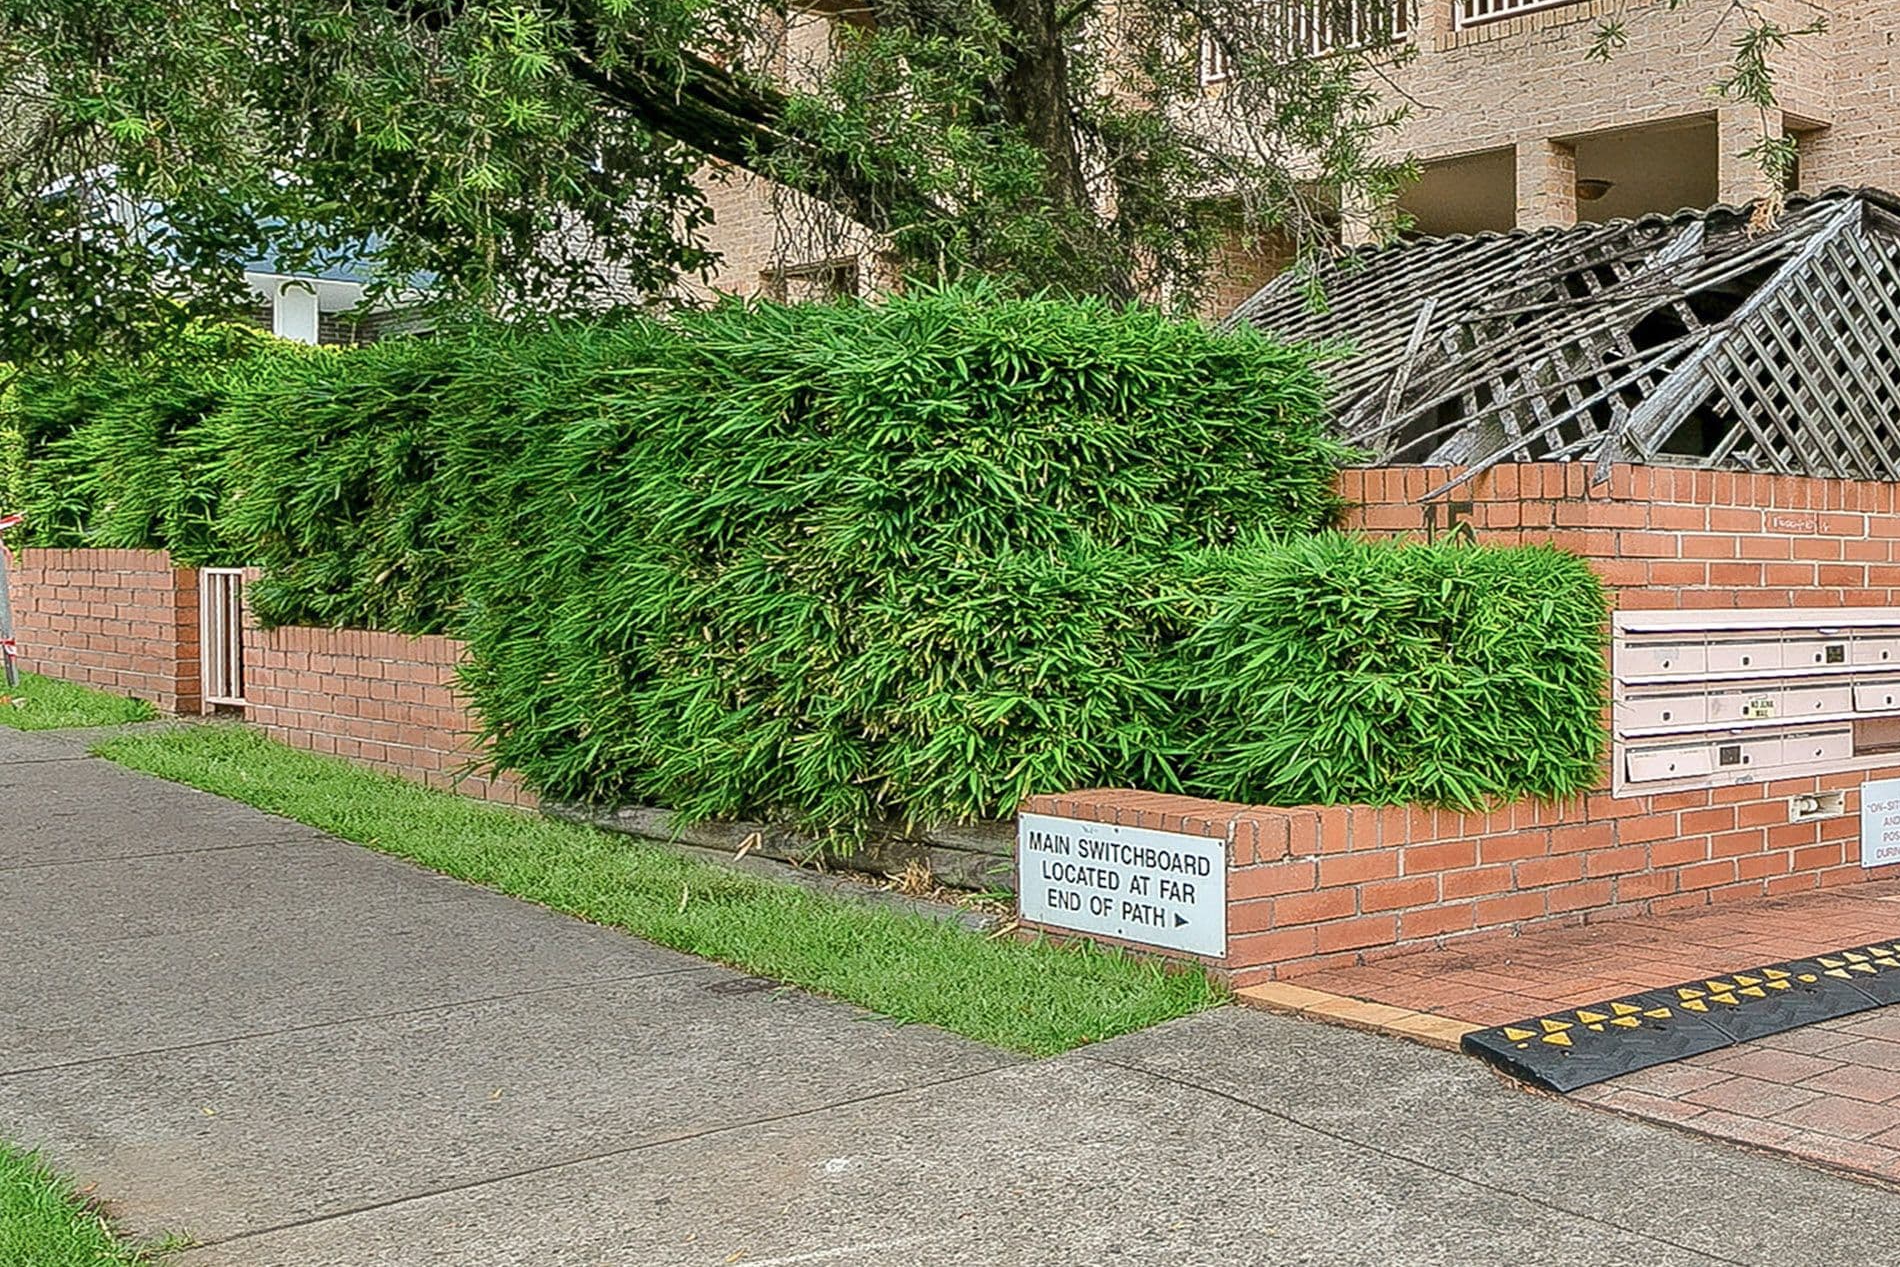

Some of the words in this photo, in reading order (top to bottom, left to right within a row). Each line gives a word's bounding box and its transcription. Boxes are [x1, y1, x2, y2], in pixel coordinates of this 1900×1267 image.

[1883, 815, 1900, 827] AND
[1029, 831, 1070, 856] MAIN
[1078, 838, 1211, 876] SWITCHBOARD
[1042, 860, 1120, 891] LOCATED
[1129, 875, 1151, 896] AT
[1160, 880, 1195, 904] FAR
[1047, 888, 1081, 912] END
[1090, 898, 1113, 917] OF
[1122, 901, 1166, 928] PATH
